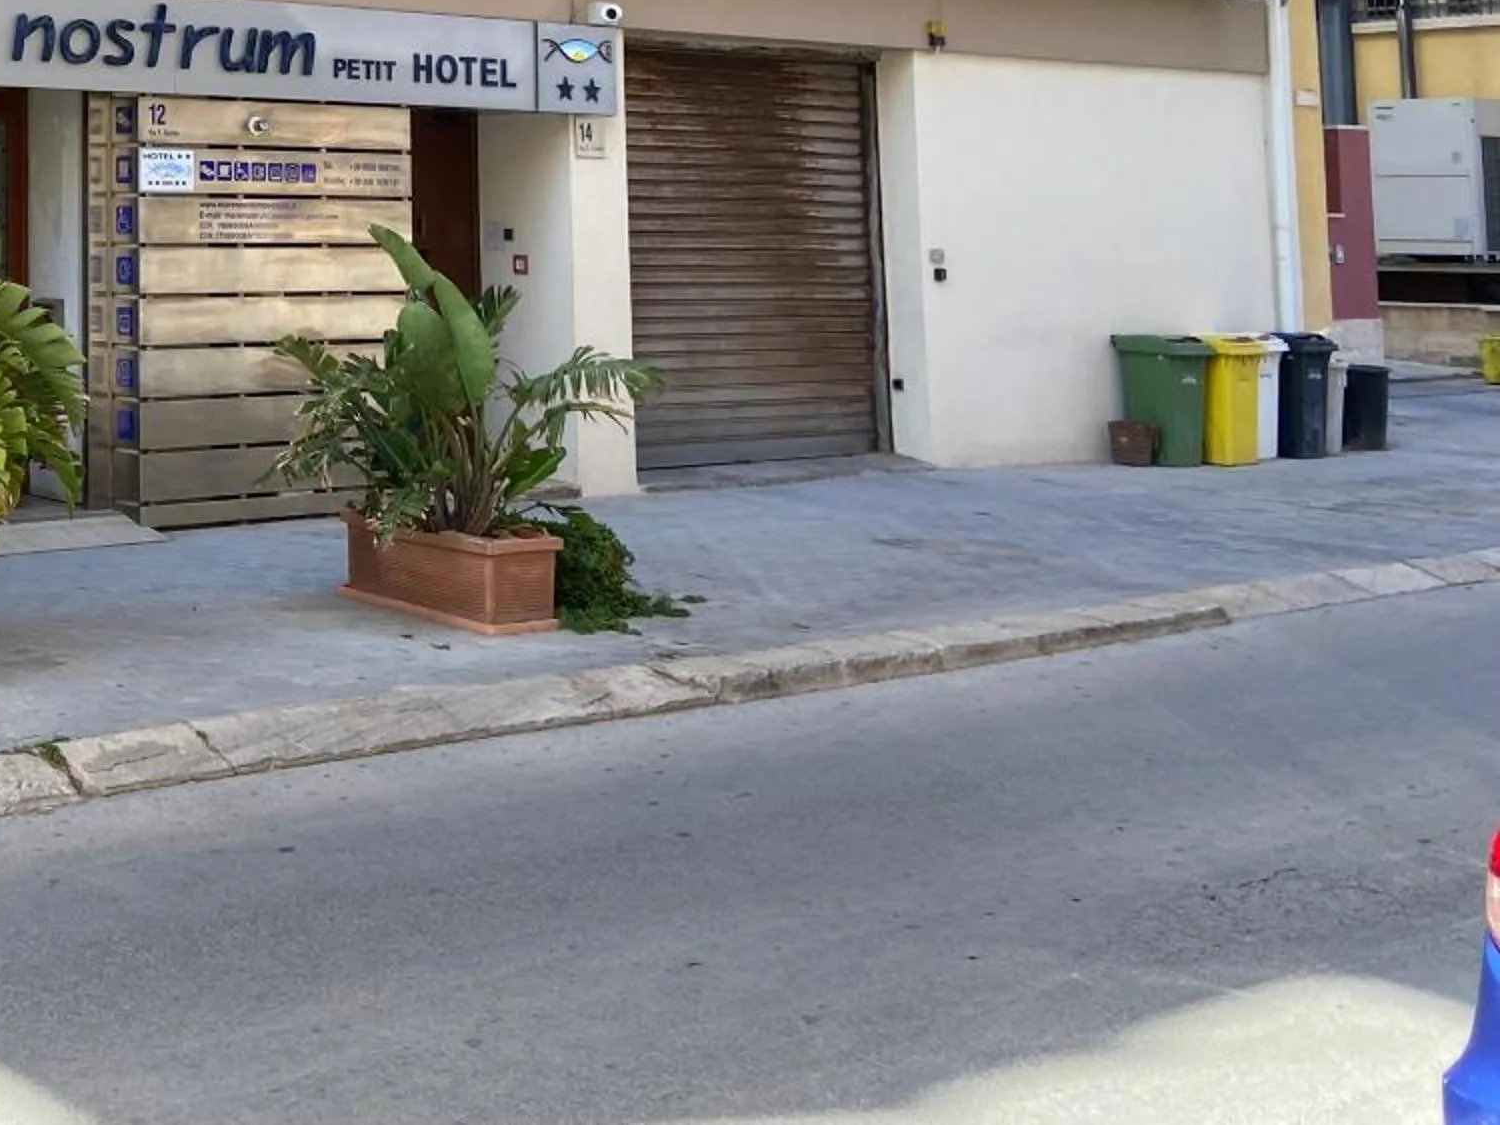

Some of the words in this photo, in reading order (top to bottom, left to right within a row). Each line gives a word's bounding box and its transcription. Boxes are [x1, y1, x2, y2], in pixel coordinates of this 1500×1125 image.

[11, 3, 316, 77] nostrum
[333, 57, 396, 82] PETIT
[412, 52, 517, 89] HOTEL
[148, 102, 167, 125] 12
[579, 122, 593, 143] 14
[143, 152, 175, 160] HOTEL
